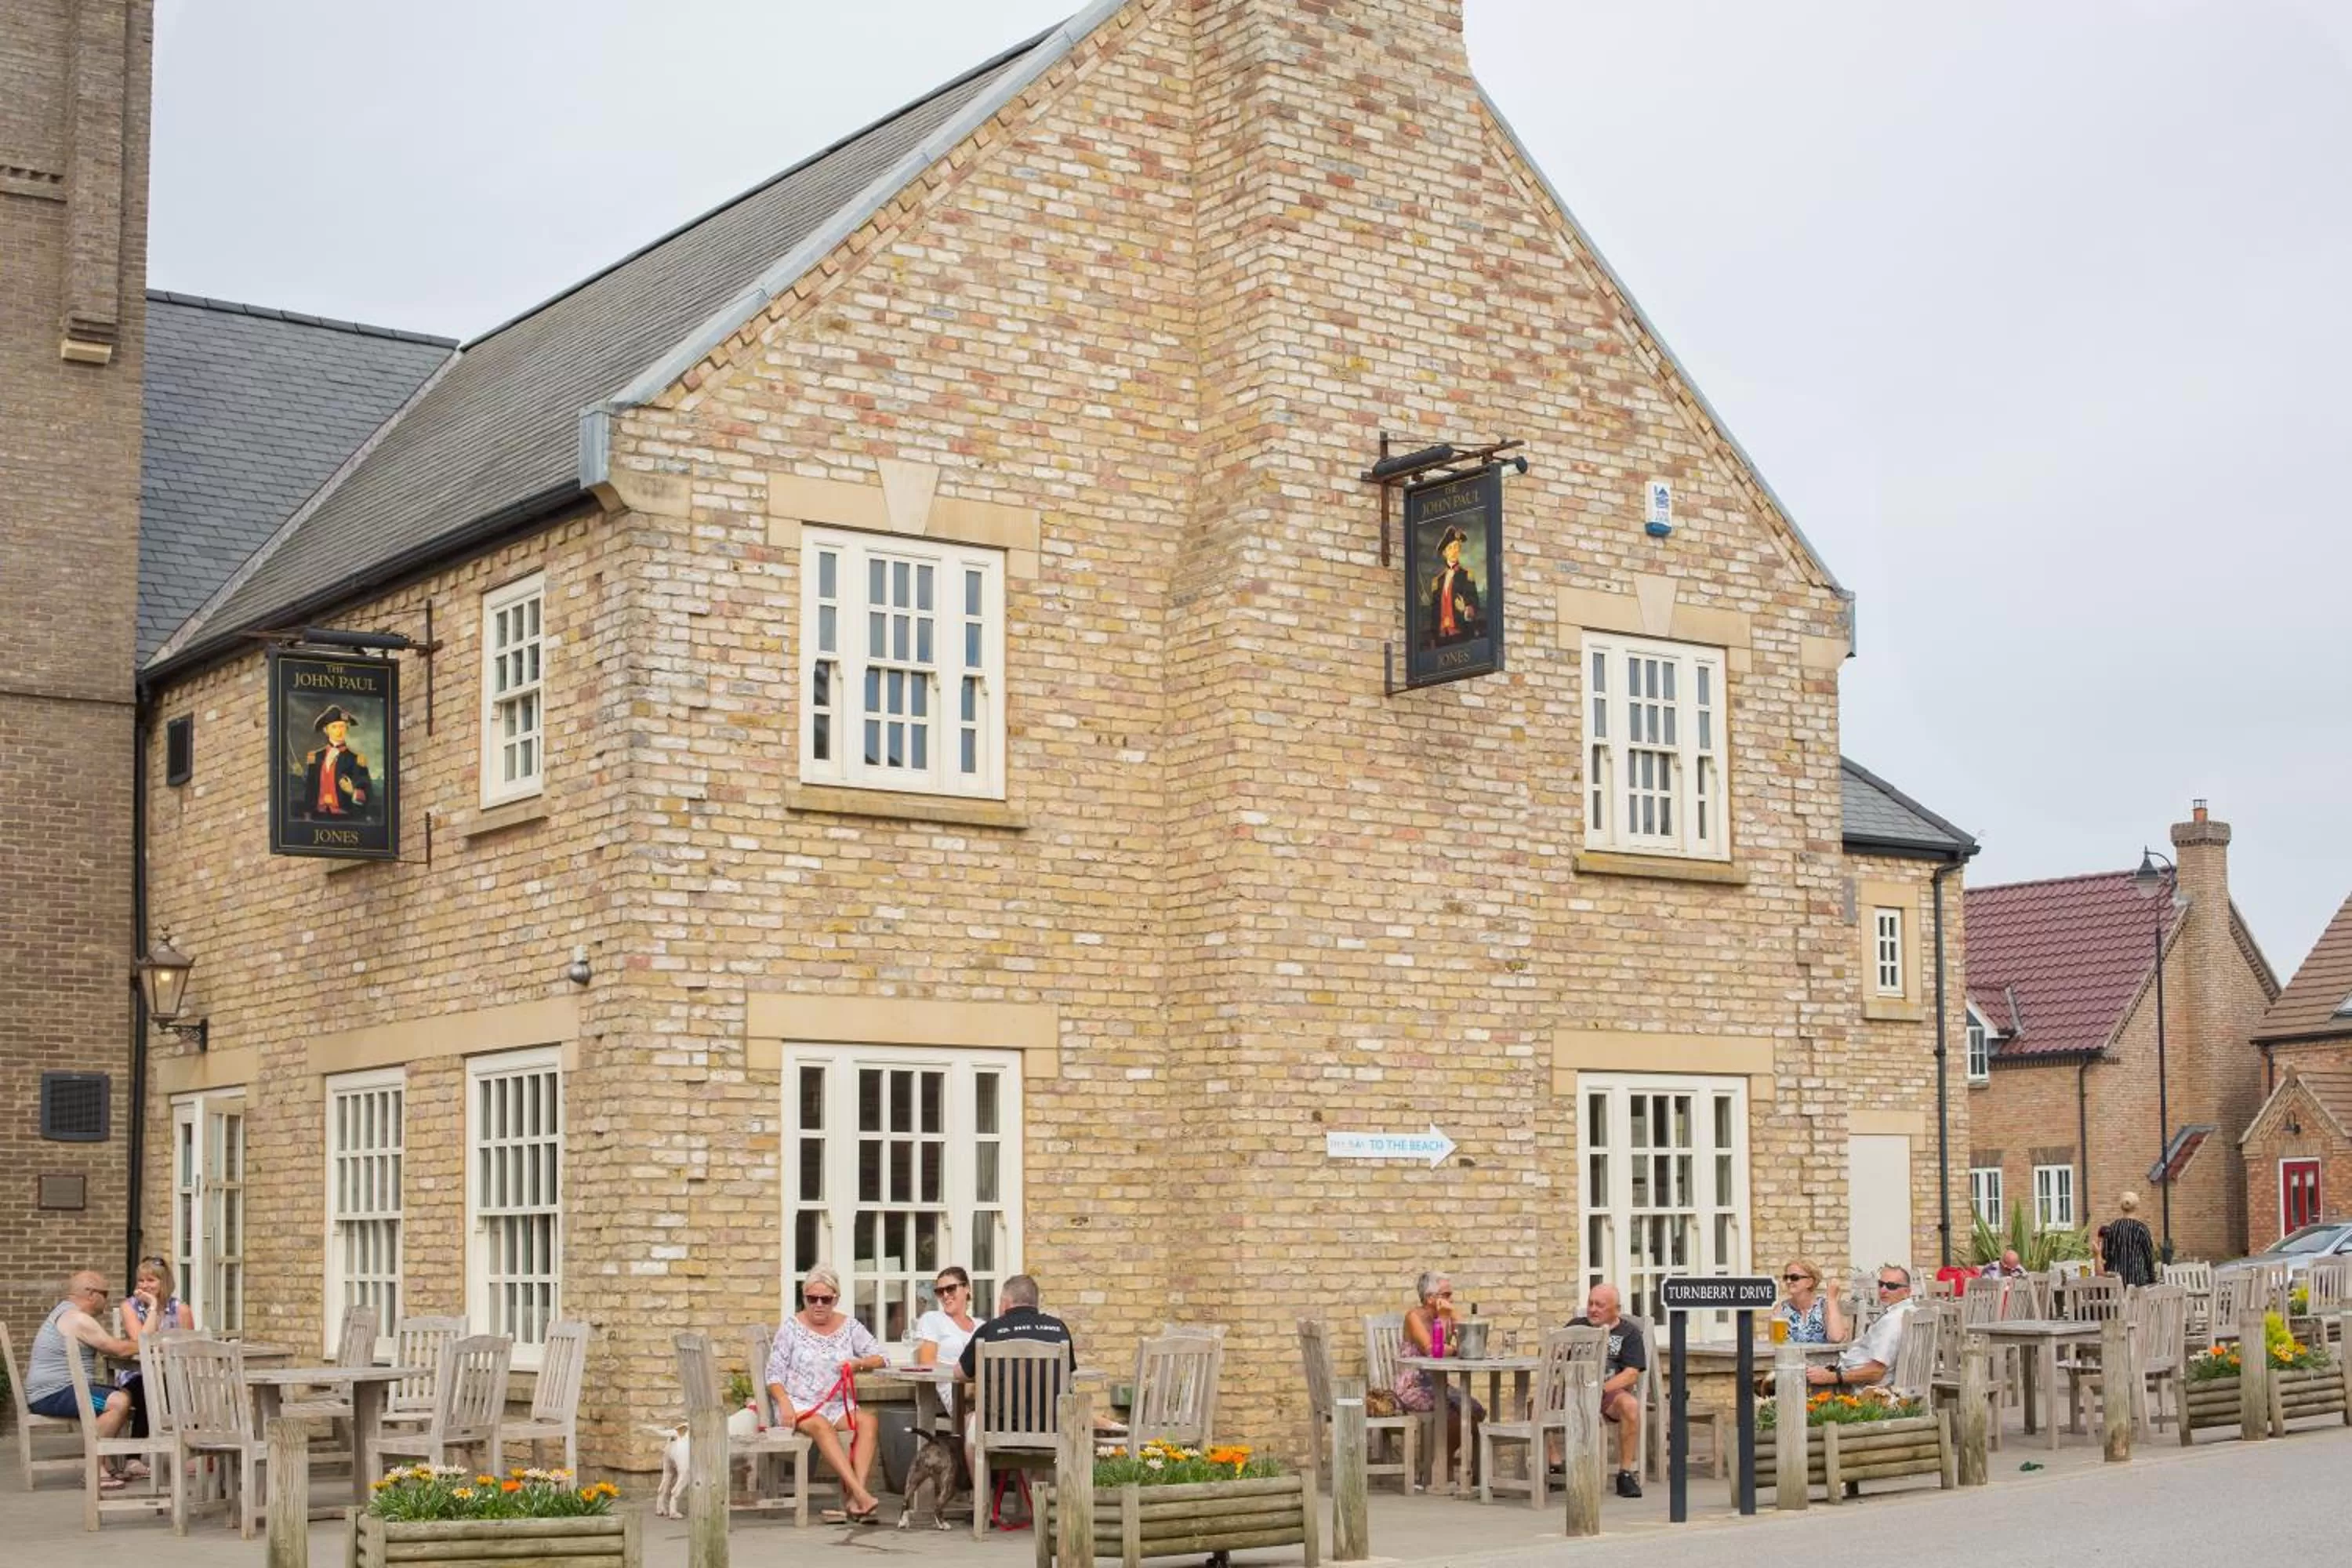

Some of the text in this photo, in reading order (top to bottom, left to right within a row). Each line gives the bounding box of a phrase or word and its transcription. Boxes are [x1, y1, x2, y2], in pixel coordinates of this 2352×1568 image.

[1421, 489, 1479, 516] JOHN PAUL
[1438, 652, 1469, 667] JONES
[326, 664, 345, 674] THE
[293, 672, 377, 691] JOHN PAUL
[314, 829, 358, 844] JONES
[1370, 1139, 1384, 1151] TO
[1386, 1139, 1407, 1152] THE
[1410, 1140, 1444, 1152] BEACH
[1668, 1285, 1773, 1300] TURNBERRY DRIVE
